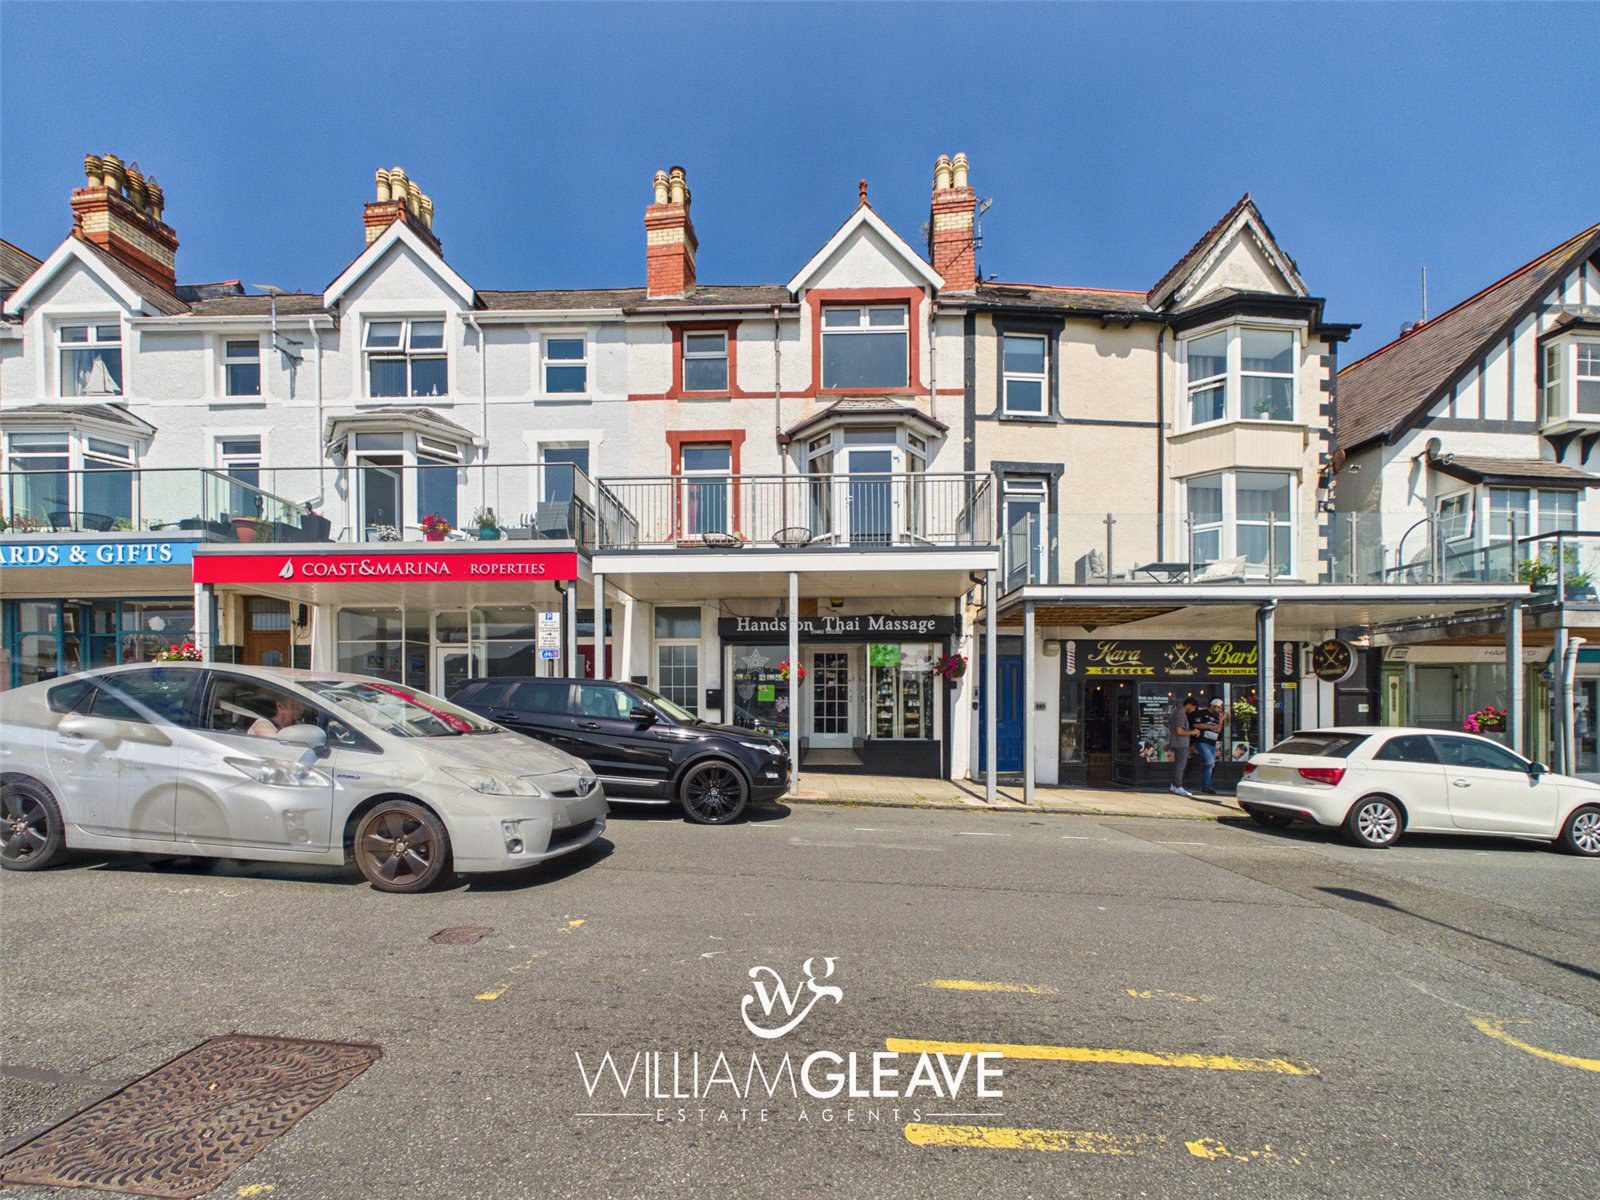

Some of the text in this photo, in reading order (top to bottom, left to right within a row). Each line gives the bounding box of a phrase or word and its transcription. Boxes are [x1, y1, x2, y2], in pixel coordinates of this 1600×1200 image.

[68, 545, 87, 563] &
[96, 543, 172, 562] GIFTS
[736, 616, 936, 633] Hands on Thai Massage
[1087, 641, 1144, 666] Kara
